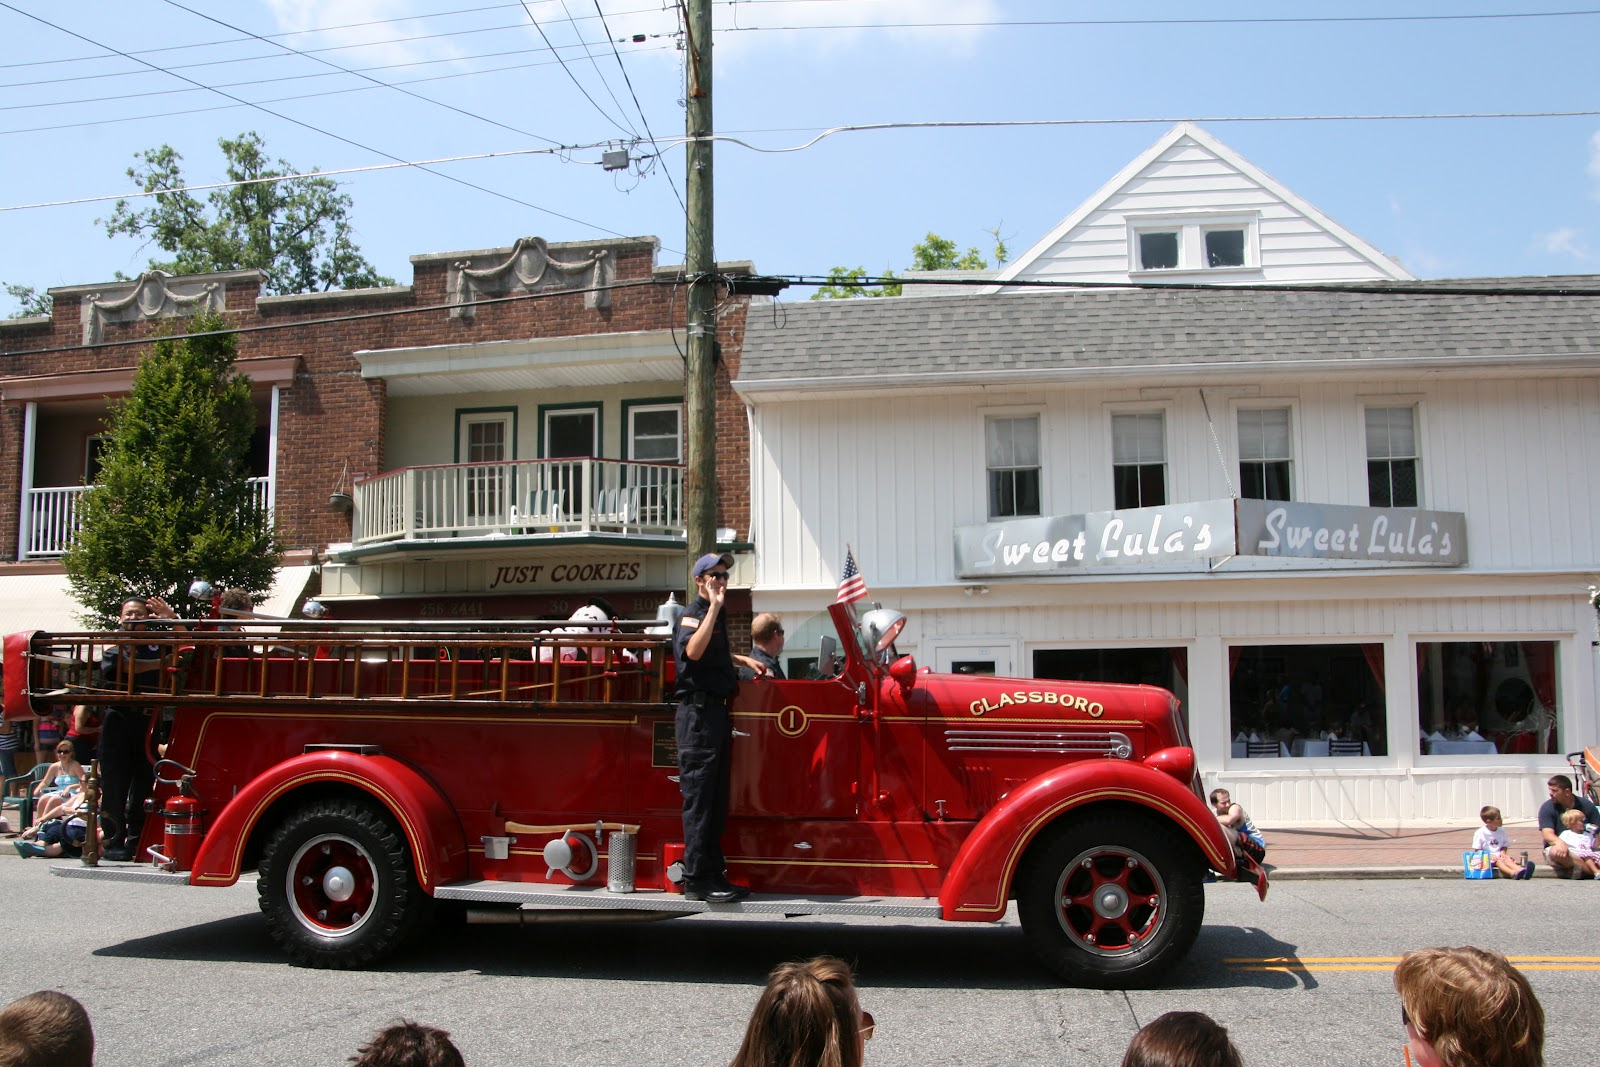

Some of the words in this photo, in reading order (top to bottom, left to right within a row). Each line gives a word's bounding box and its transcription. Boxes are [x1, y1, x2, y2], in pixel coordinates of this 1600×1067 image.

[974, 528, 1086, 568] Sweet
[1096, 514, 1211, 561] Lula's
[1258, 508, 1359, 552] Sweet
[1367, 515, 1452, 557] Lula's
[490, 565, 543, 588] JUST
[551, 562, 641, 582] COOKIES
[970, 691, 1104, 718] GLASSBORO
